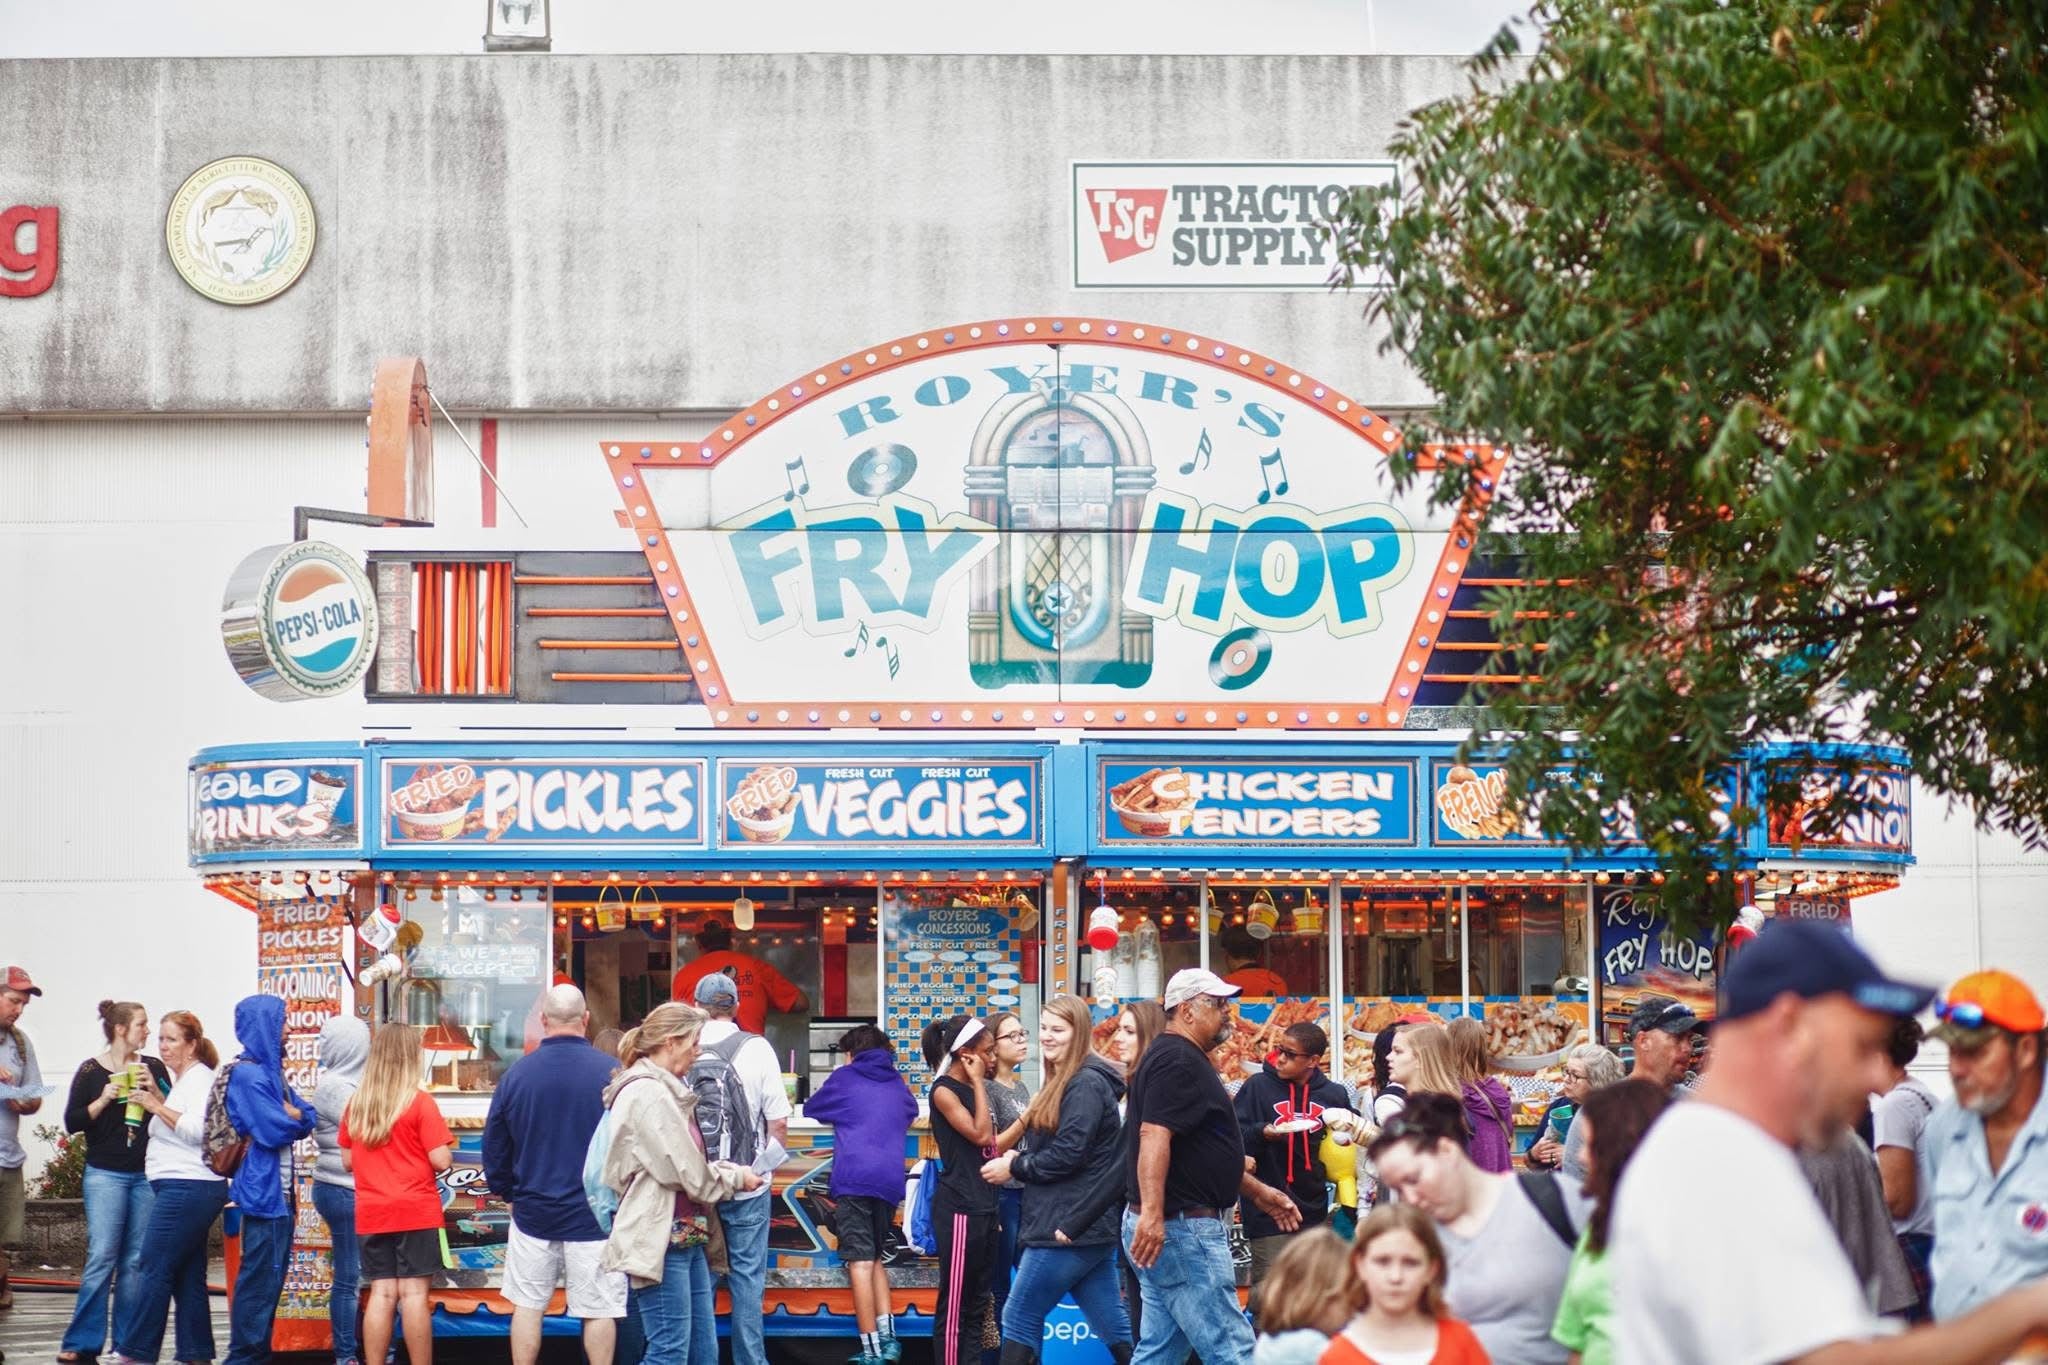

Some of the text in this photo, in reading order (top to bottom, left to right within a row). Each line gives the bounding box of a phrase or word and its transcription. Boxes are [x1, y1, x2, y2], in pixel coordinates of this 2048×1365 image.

[1094, 191, 1155, 249] TSC
[1172, 227, 1330, 266] SUPPLY
[833, 363, 1285, 440] ROYER'S
[728, 502, 1399, 625] FRY HOP
[825, 768, 894, 778] FRESH CUT
[922, 768, 991, 778] FRESH CUT
[1153, 770, 1393, 801] CHICKEN
[395, 765, 474, 814] FRIED
[483, 768, 694, 834] PICKLES
[728, 767, 797, 820] FRIED
[196, 802, 329, 841] RINKS
[799, 778, 1027, 836] VEGGIES
[1165, 808, 1381, 837] TENDERS
[273, 903, 331, 924] FRIED
[928, 909, 979, 922] ROYERS
[1789, 901, 1840, 920] FRIED
[262, 926, 341, 949] PICKLES
[916, 922, 992, 935] CONCESSIONS
[458, 947, 489, 959] WE
[1604, 933, 1714, 985] FRY HOP
[928, 965, 946, 973] ADD
[948, 965, 980, 973] CHEESE
[888, 996, 928, 1004] CHICKEN
